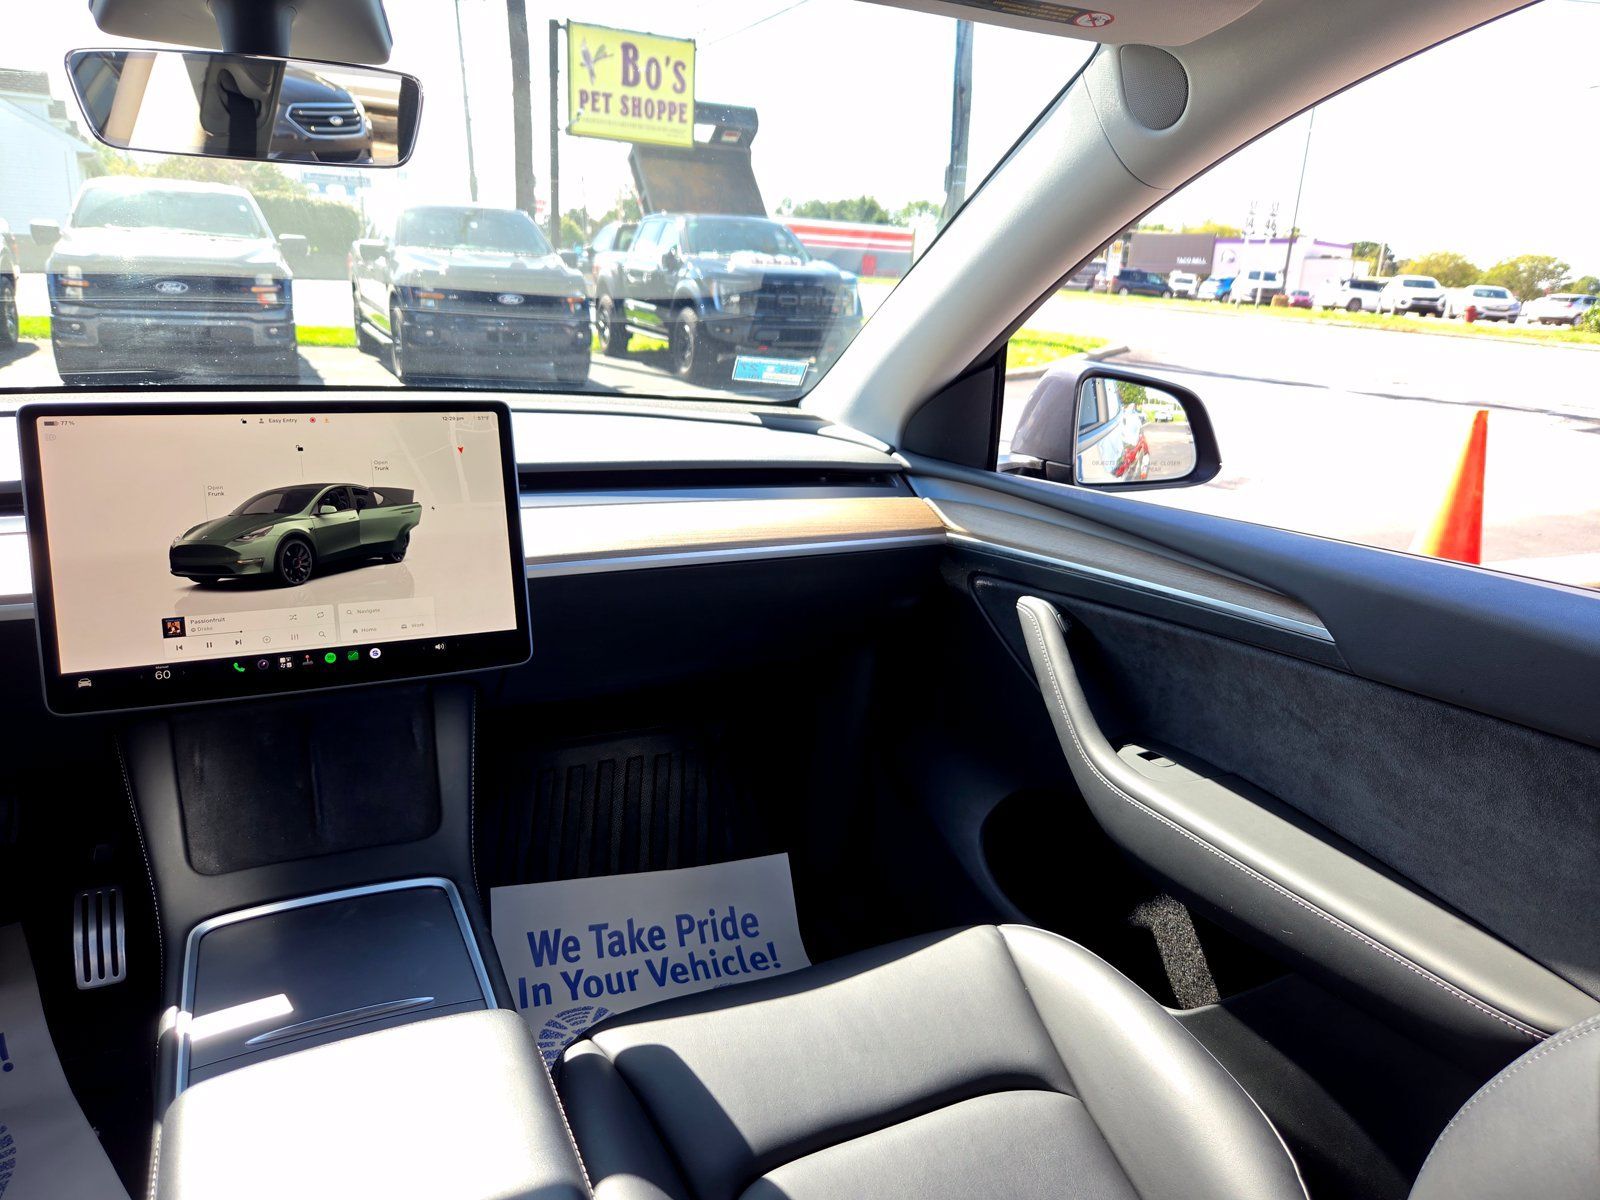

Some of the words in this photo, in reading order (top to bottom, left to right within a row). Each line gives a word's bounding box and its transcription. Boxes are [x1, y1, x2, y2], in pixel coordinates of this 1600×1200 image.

[579, 89, 613, 115] PET
[621, 95, 688, 124] SHOPPE
[1176, 256, 1191, 264] TACO
[155, 670, 171, 680] 60
[526, 927, 581, 968] We
[588, 917, 667, 959] Take
[675, 905, 760, 947] Pride
[517, 976, 553, 1010] In
[560, 967, 639, 1002] Your
[645, 941, 782, 988] Vehicle!
